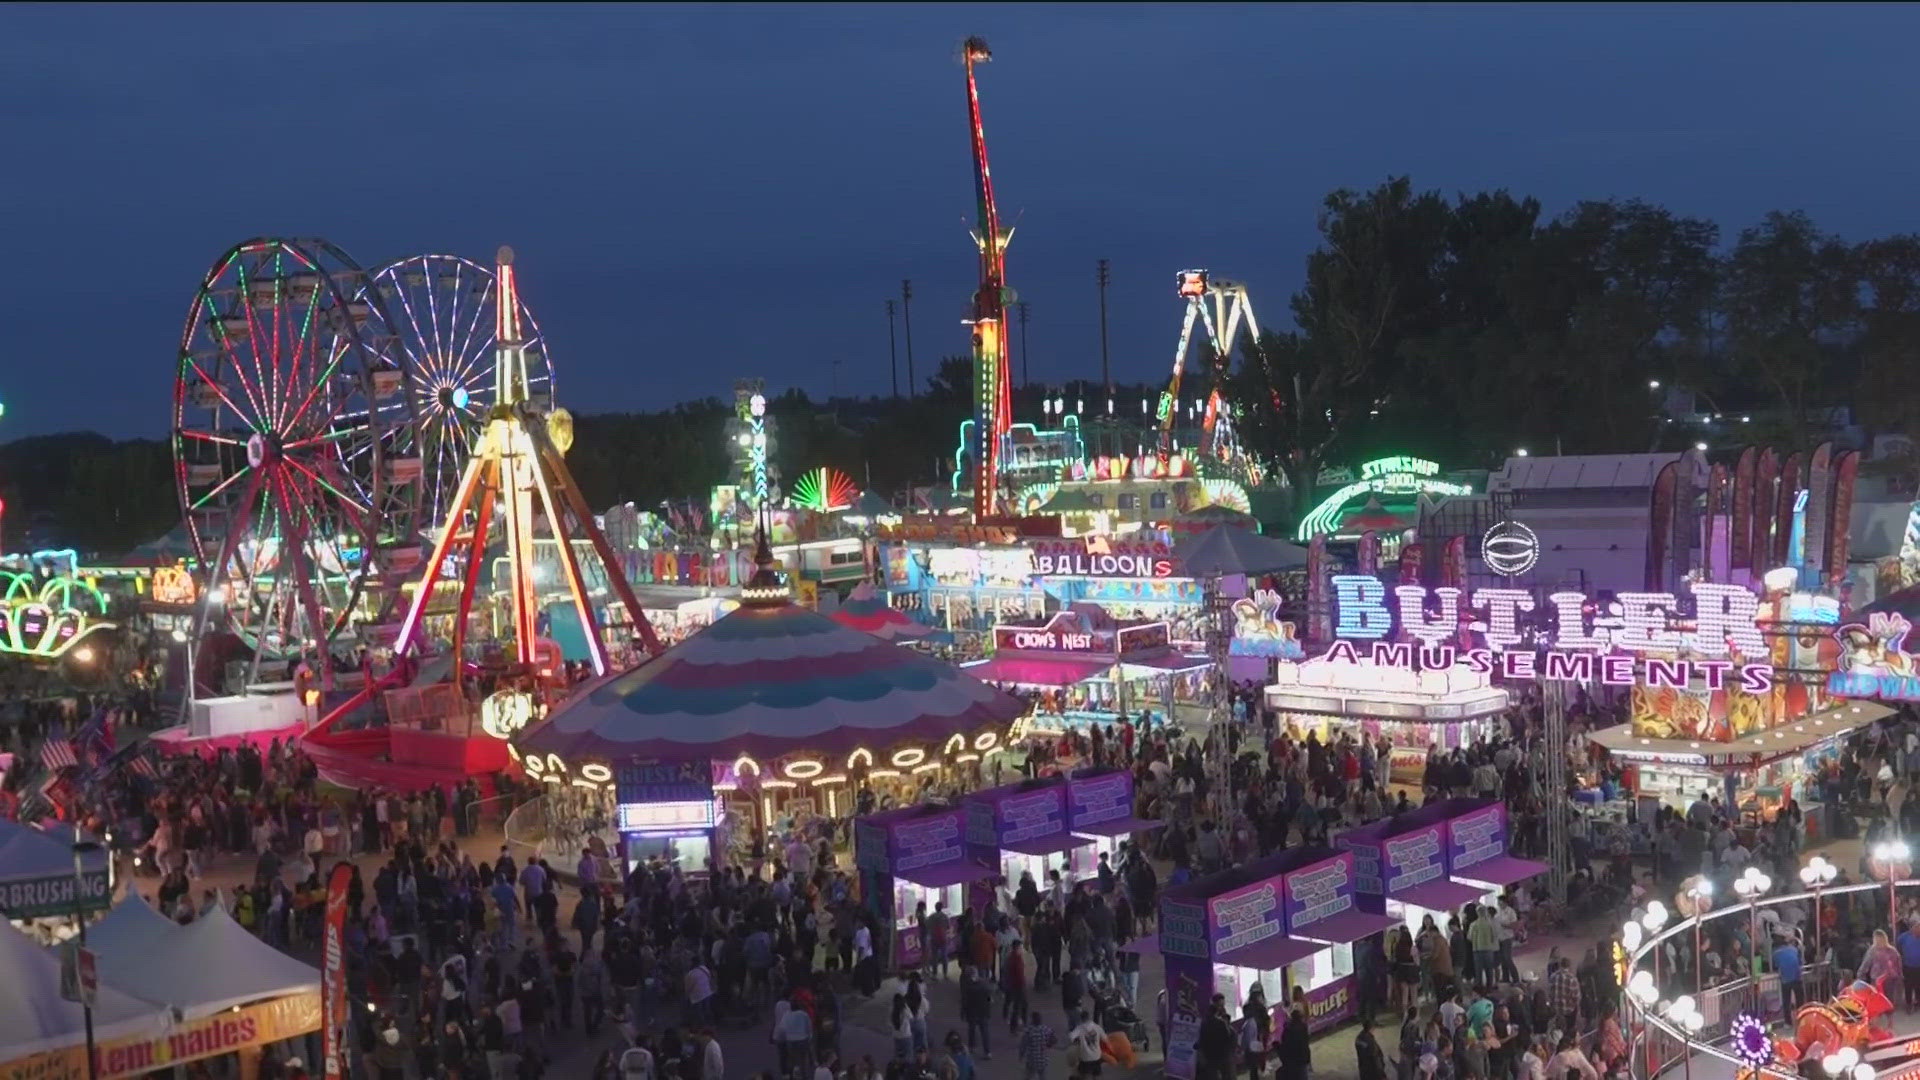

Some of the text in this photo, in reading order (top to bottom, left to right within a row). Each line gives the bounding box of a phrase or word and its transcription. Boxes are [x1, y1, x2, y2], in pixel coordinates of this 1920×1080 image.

[1362, 456, 1439, 480] STARSHIP
[1385, 474, 1415, 487] 3000
[1039, 554, 1172, 577] BALLOONS
[1331, 575, 1770, 657] BUTLER
[1015, 632, 1092, 650] CROW'S NEST
[1324, 640, 1773, 694] AMUSEMENTS
[1307, 987, 1347, 1017] UTLER
